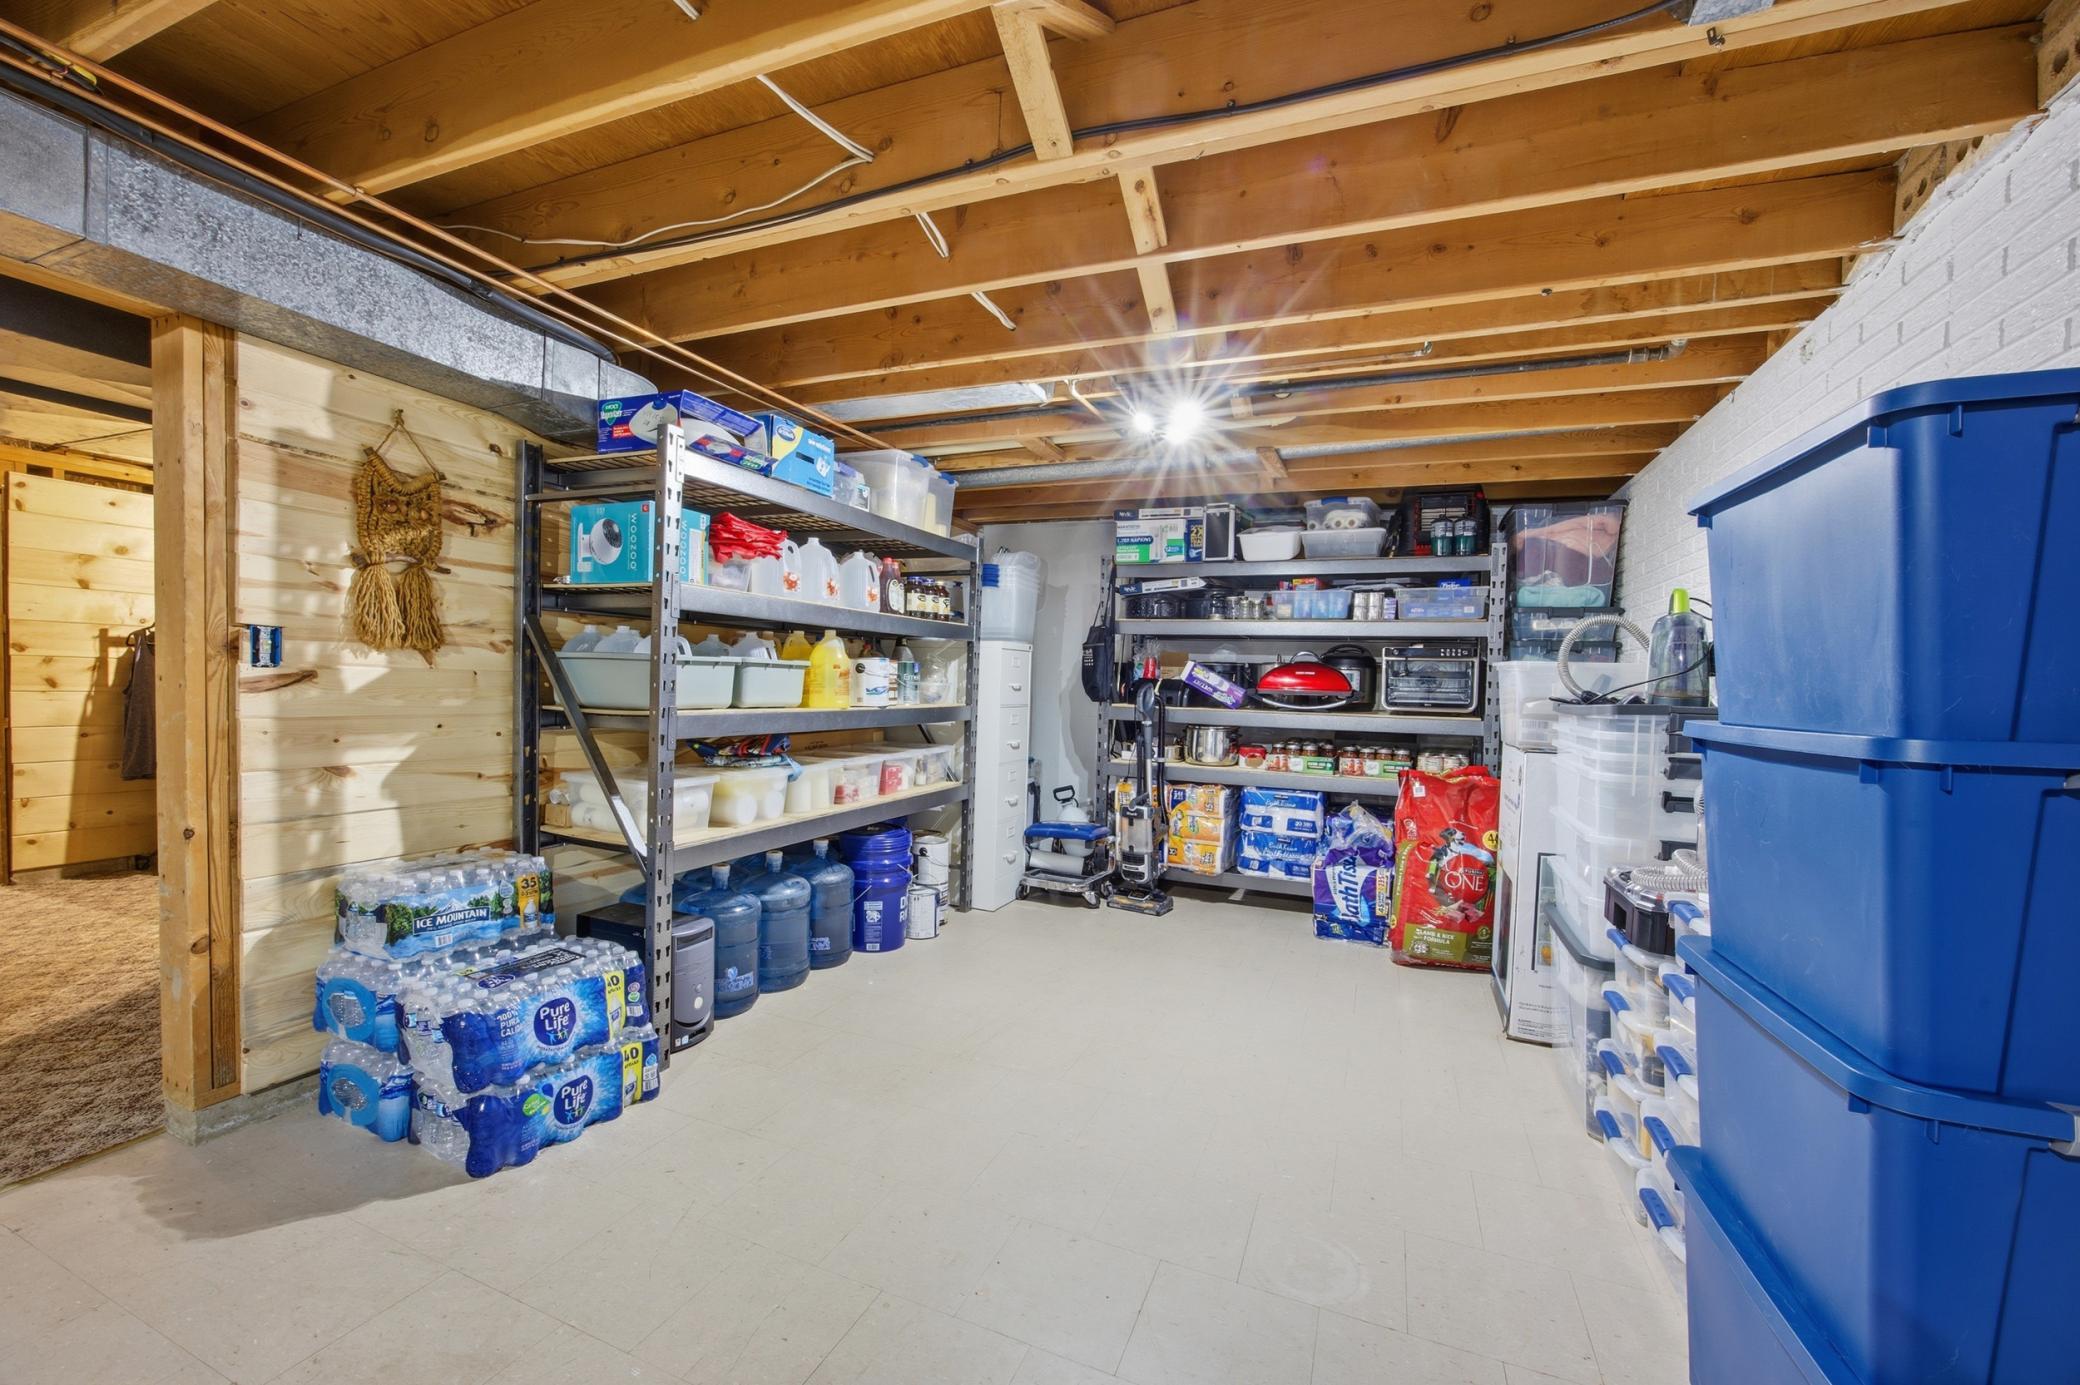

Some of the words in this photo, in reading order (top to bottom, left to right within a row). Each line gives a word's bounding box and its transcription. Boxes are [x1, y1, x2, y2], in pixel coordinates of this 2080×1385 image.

[630, 512, 638, 570] WOOZOO
[680, 520, 688, 575] WOOZOO
[521, 876, 537, 889] 35
[1444, 871, 1485, 893] ONE
[416, 917, 433, 929] ICE
[436, 908, 487, 926] MOUNTAIN
[540, 1001, 570, 1020] Pure
[544, 1014, 569, 1031] Life
[623, 1046, 639, 1062] 40
[561, 1079, 588, 1099] Pure
[564, 1092, 588, 1111] Life
